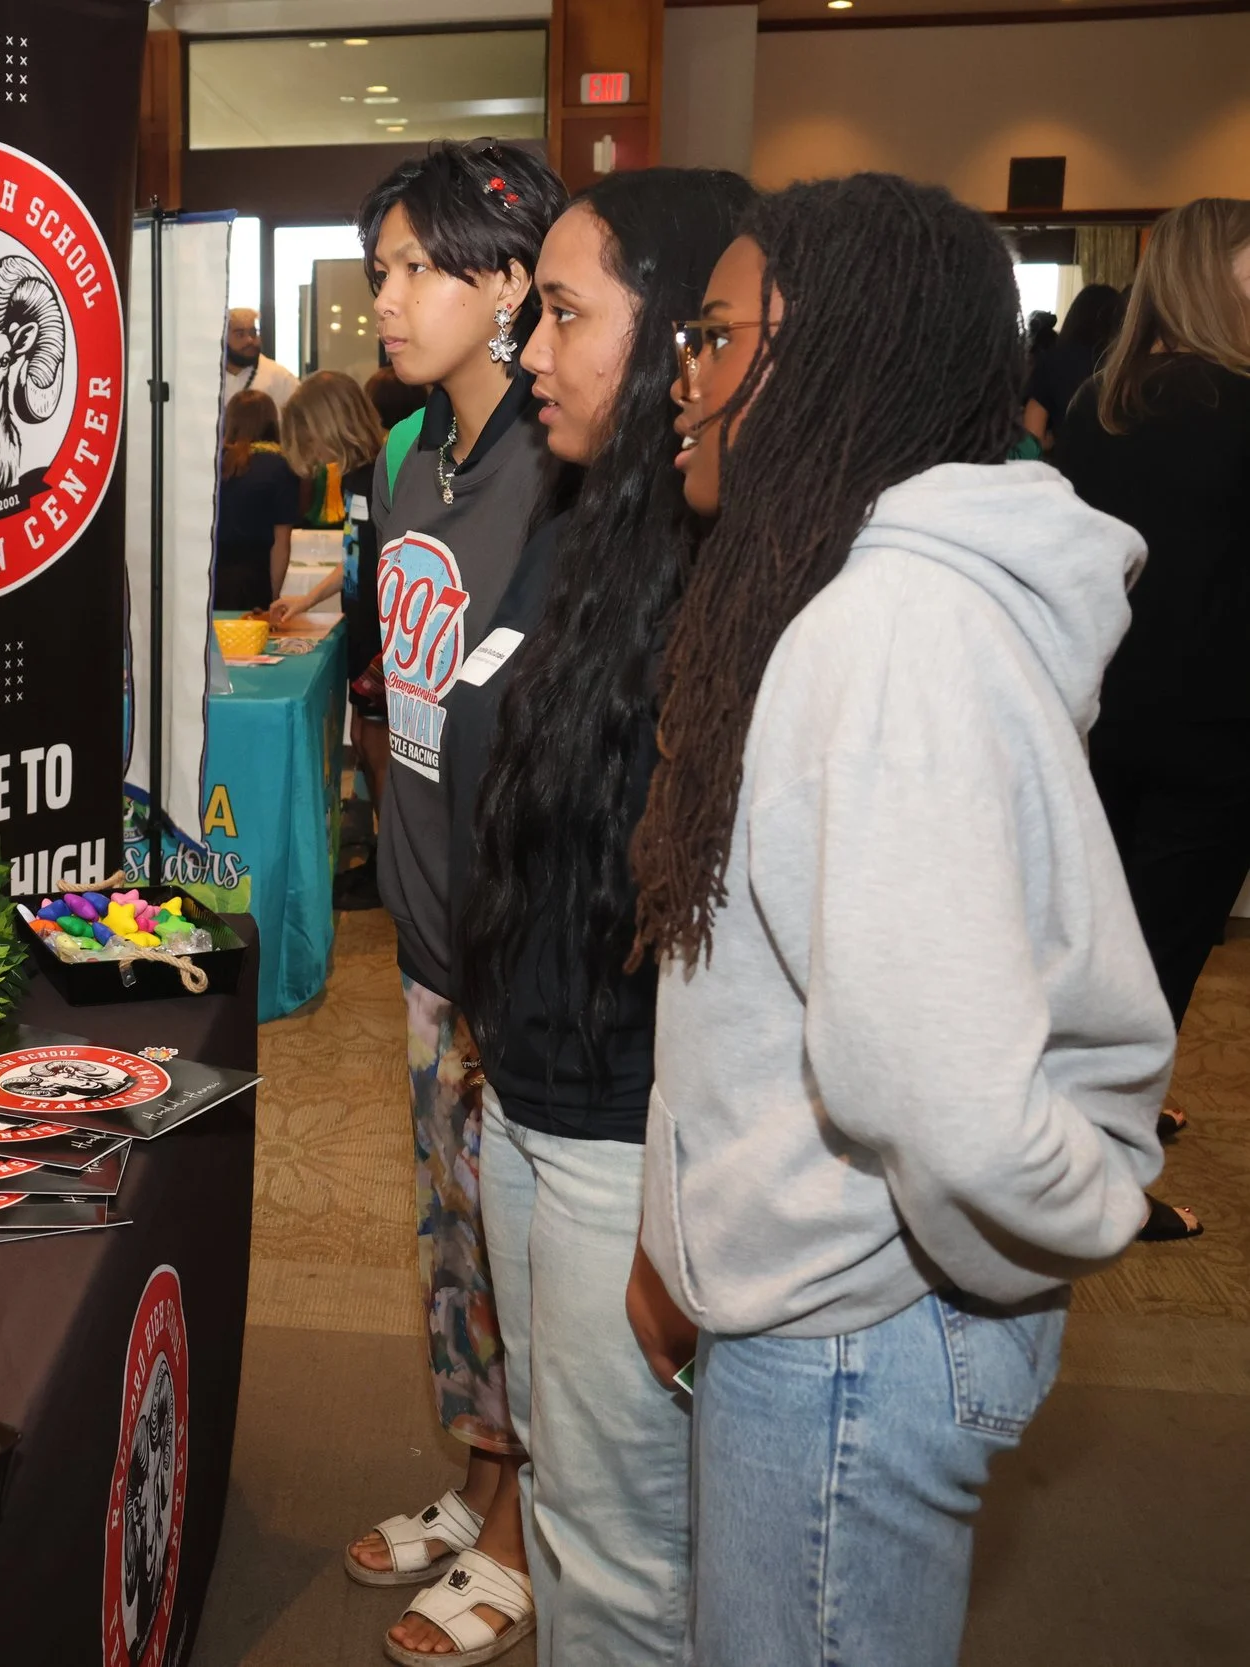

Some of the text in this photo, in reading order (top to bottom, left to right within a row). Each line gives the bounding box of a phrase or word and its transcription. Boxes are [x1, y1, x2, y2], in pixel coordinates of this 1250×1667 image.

[589, 73, 625, 103] EXIT
[25, 196, 102, 308] SCHOOL
[23, 376, 111, 550] CENTER
[387, 672, 439, 704] Championship
[390, 691, 445, 749] DWAY
[20, 743, 73, 816] TO
[409, 743, 439, 767] RACING
[11, 838, 106, 896] HIGH
[18, 1050, 79, 1062] SCHOOL
[21, 1055, 160, 1110] TRANSITION CENTER
[144, 1299, 165, 1355] HIGH
